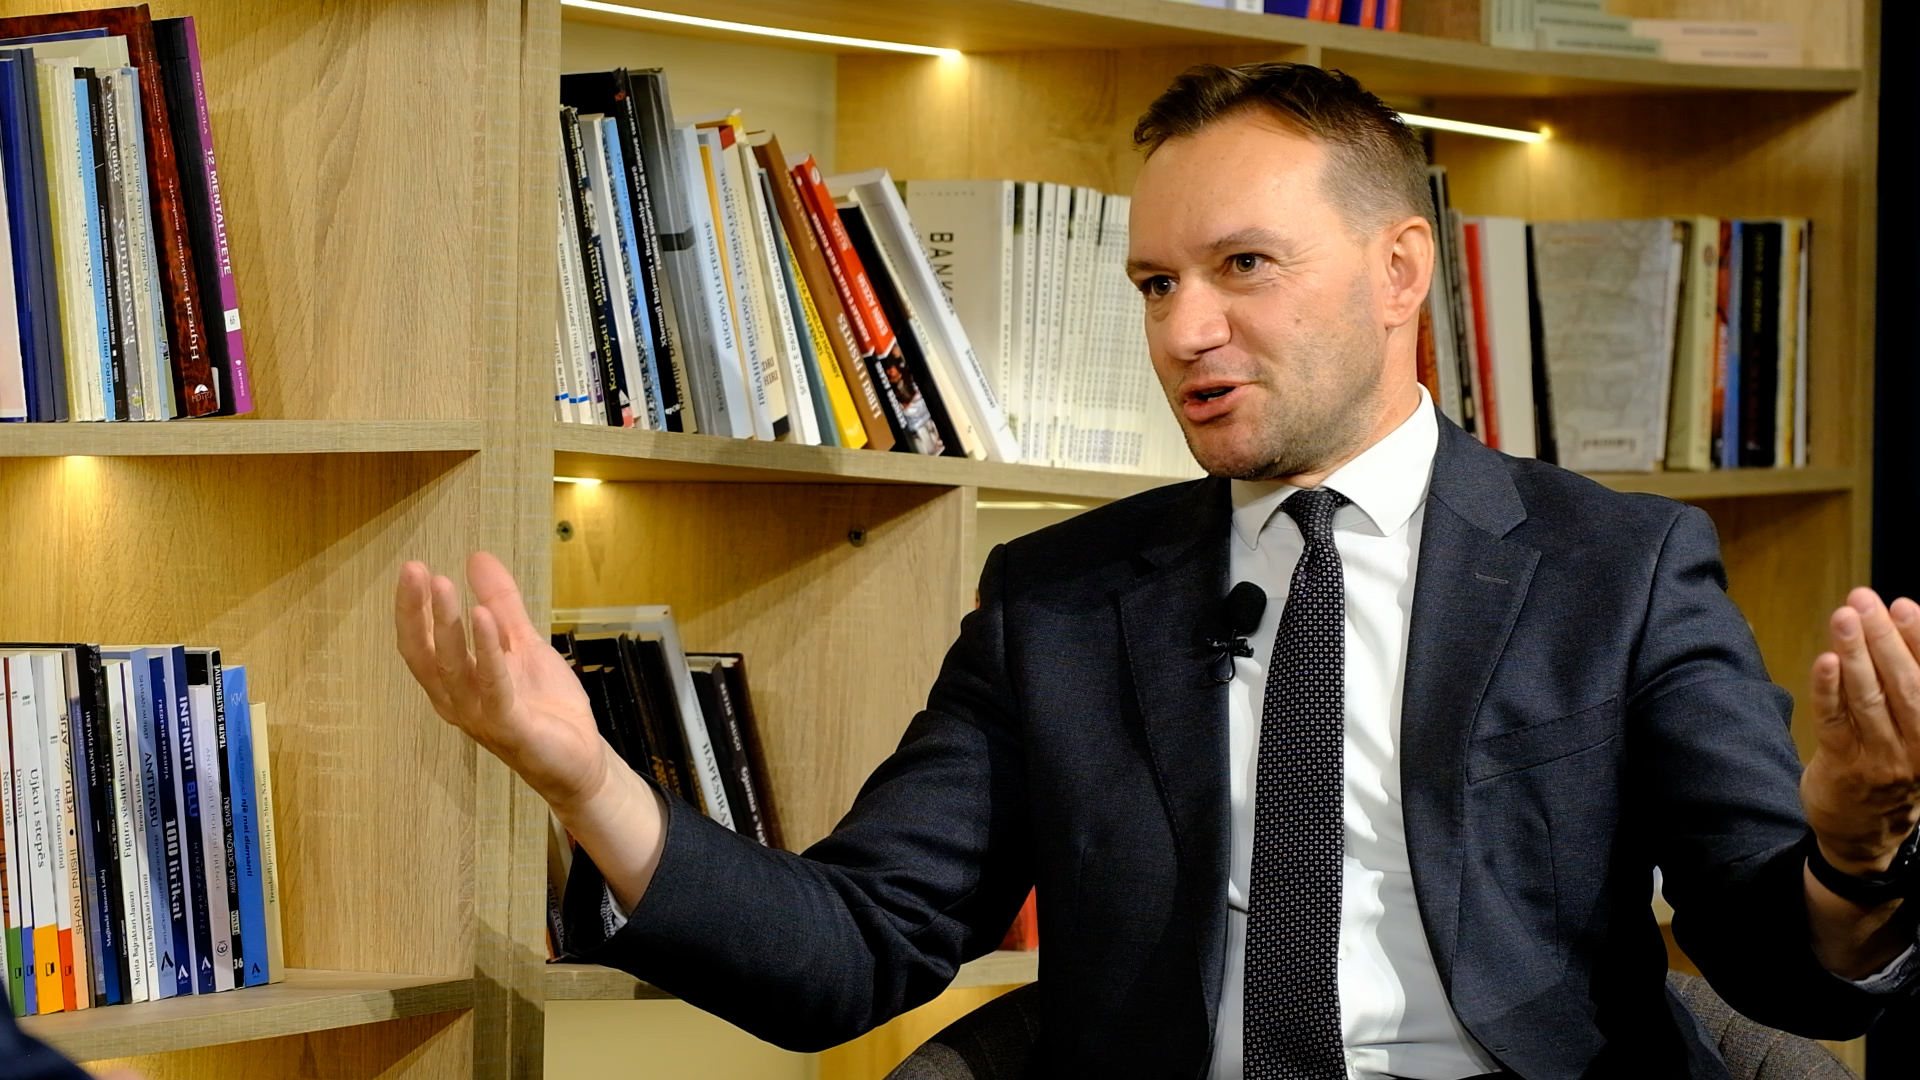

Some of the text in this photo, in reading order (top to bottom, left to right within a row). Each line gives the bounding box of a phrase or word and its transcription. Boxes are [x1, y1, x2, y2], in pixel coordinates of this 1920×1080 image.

[107, 93, 117, 142] MORAVA
[208, 148, 215, 165] 12
[632, 166, 640, 192] vrarë
[211, 171, 230, 274] MENTALITETE
[639, 202, 651, 256] Buzëqeshje
[643, 188, 655, 235] SHQIPTARE
[731, 230, 742, 276] TEORIA
[763, 211, 777, 263] MEHMETAJ
[588, 243, 602, 306] shkrimit
[649, 265, 660, 303] Bajrami
[930, 232, 954, 303] BANK
[655, 306, 667, 347] Xhemajl
[719, 297, 732, 349] RUGOVA
[742, 296, 755, 347] RUGOVA
[858, 273, 888, 336] EMIN AZEMI
[601, 324, 616, 390] Konteksti
[751, 350, 764, 405] IBRAHIM
[795, 364, 806, 395] SFIDAT
[859, 371, 866, 380] I
[863, 380, 881, 418] LIBRI
[61, 715, 69, 745] ATJE
[720, 683, 731, 716] BETIM
[730, 720, 741, 751] MUÇO
[741, 766, 756, 812] Gjurma
[180, 697, 198, 817] INFINITI BLU
[16, 768, 25, 818] Demiani
[65, 780, 73, 814] KËTU
[115, 718, 132, 858] Figura vështrime letrare
[144, 752, 157, 827] ANTITABU
[224, 797, 232, 827] DEMIRAJ
[29, 768, 39, 805] Ujku
[34, 820, 45, 868] stepës
[70, 849, 82, 935] SHANI PNISHI
[166, 820, 181, 920] 100 lirikat
[131, 919, 139, 957] Bajraktari
[145, 902, 153, 940] Bajraktari
[230, 910, 240, 935] FRYMA
[233, 957, 244, 970] 36
